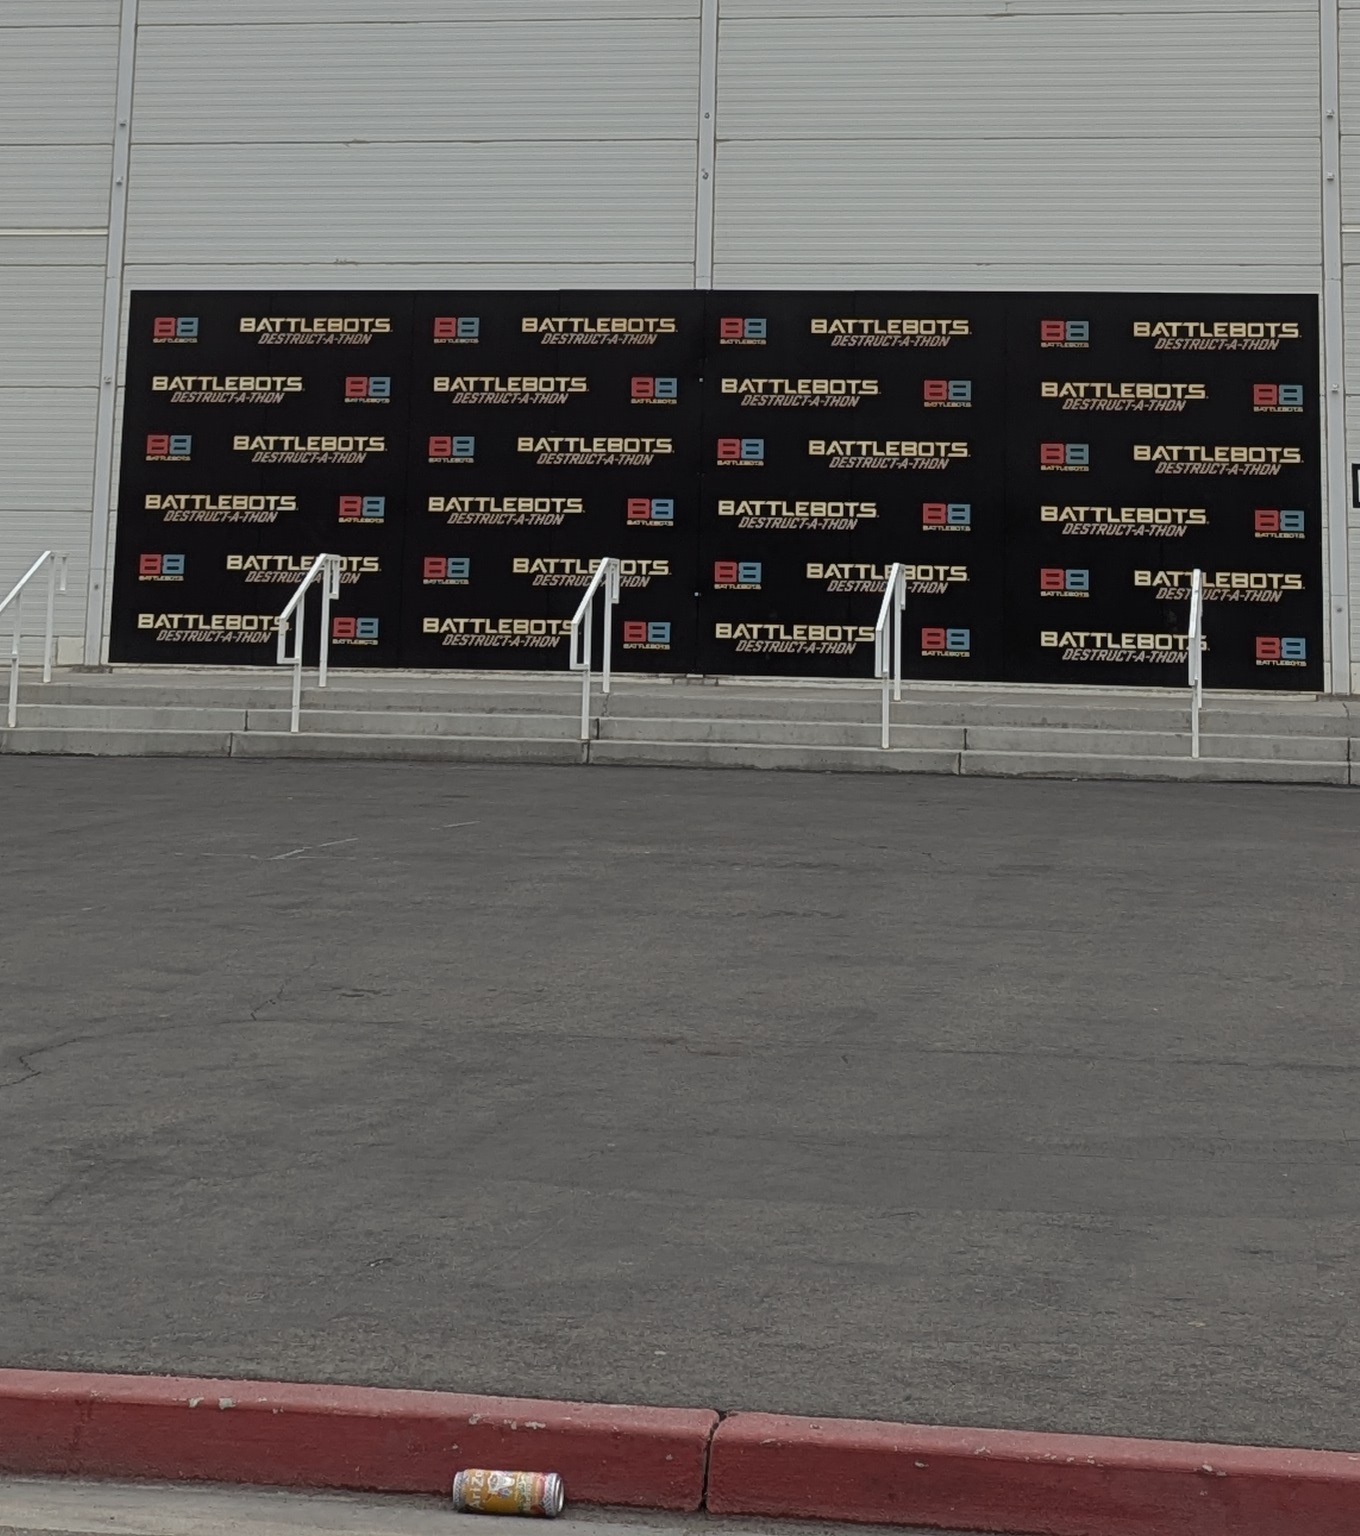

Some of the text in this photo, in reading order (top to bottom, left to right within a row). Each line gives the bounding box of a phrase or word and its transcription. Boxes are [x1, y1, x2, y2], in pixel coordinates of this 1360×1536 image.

[240, 318, 390, 332] BATTLEBOTS
[522, 318, 677, 332] BATTLEBOTS
[811, 319, 971, 334] BATTLEBOTS
[1134, 322, 1298, 338] BATTLEBOTS
[259, 333, 372, 344] DESTRUCT-A-THON
[542, 333, 657, 344] DESTRUCT-A-THON
[832, 335, 950, 346] DESTRUCT-A-THON
[1155, 338, 1279, 350] DESTRUCT-A-THON
[152, 376, 302, 391] BATTLEBOTS
[434, 377, 586, 392] BATTLEBOTS
[722, 379, 878, 394] BATTLEBOTS
[1042, 382, 1205, 399] BATTLEBOTS
[171, 392, 284, 403] DESTRUCT-A-THON
[453, 393, 568, 403] DESTRUCT-A-THON
[741, 395, 859, 407] DESTRUCT-A-THON
[1063, 399, 1186, 411] DESTRUCT-A-THON
[234, 436, 384, 451] BATTLEBOTS
[518, 437, 672, 453] BATTLEBOTS
[809, 440, 967, 457] BATTLEBOTS
[252, 452, 366, 463] DESTRUCT-A-THON
[537, 453, 653, 465] DESTRUCT-A-THON
[1134, 445, 1300, 463] BATTLEBOTS
[829, 457, 949, 469] DESTRUCT-A-THON
[1156, 462, 1281, 475] DESTRUCT-A-THON
[145, 495, 296, 510] BATTLEBOTS
[429, 497, 582, 513] BATTLEBOTS
[718, 501, 876, 517] BATTLEBOTS
[164, 510, 278, 522] DESTRUCT-A-THON
[448, 513, 564, 525] DESTRUCT-A-THON
[1041, 506, 1206, 524] BATTLEBOTS
[739, 517, 857, 529] DESTRUCT-A-THON
[1062, 523, 1187, 536] DESTRUCT-A-THON
[512, 557, 669, 575] BATTLEOTS
[1155, 587, 1283, 603] DESTUCT-A-THON
[156, 630, 272, 643] DESTRUCT-A-THON
[715, 623, 876, 642] BATTLEBOTS
[442, 634, 561, 648] DESTRUCT-A-THON
[735, 640, 857, 655] DESTRUCT-A-THON
[1061, 647, 1188, 664] DESTRUCT-A-THON
